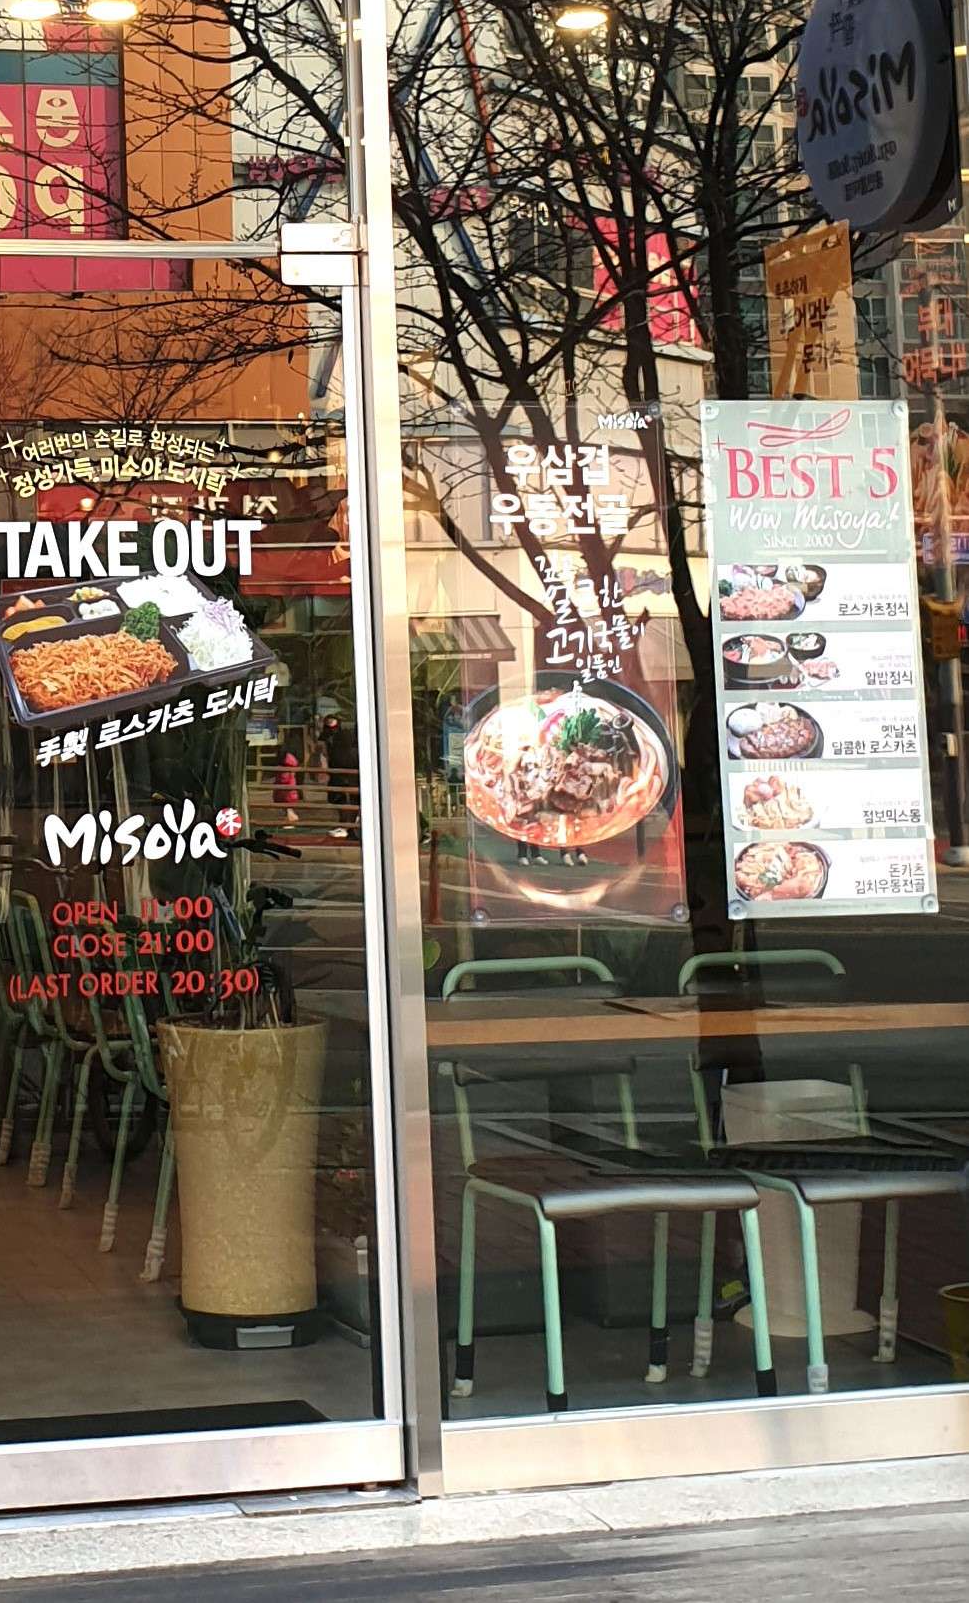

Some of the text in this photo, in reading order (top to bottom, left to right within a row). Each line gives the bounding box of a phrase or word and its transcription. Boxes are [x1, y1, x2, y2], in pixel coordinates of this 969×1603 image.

[22, 428, 216, 464] 여러번의 손길로 완성되는
[101, 454, 164, 482] 미소야
[165, 460, 228, 498] 도시락
[504, 444, 610, 487] 우삼겹
[725, 447, 899, 499] BEST 5
[489, 493, 631, 536] 우동전골
[729, 503, 781, 532] Wow
[793, 501, 900, 549] Misoya!
[152, 519, 263, 577] OUT
[837, 602, 910, 617] 로스카츠정식
[545, 614, 646, 666] 고기국물이
[575, 653, 623, 684] 일품인
[865, 670, 914, 686] 알밥정식
[94, 699, 194, 750] 로스카츠
[201, 674, 280, 721] 도시락
[831, 739, 917, 756] 달콤한 로스카츠
[854, 878, 926, 895] 김치우동전골
[888, 862, 926, 878] 돈카츠
[52, 896, 214, 927] OPEN 11:00
[53, 929, 215, 959] CLOSE 21:00
[9, 973, 72, 1004] (LAST
[78, 972, 159, 997] ORDER
